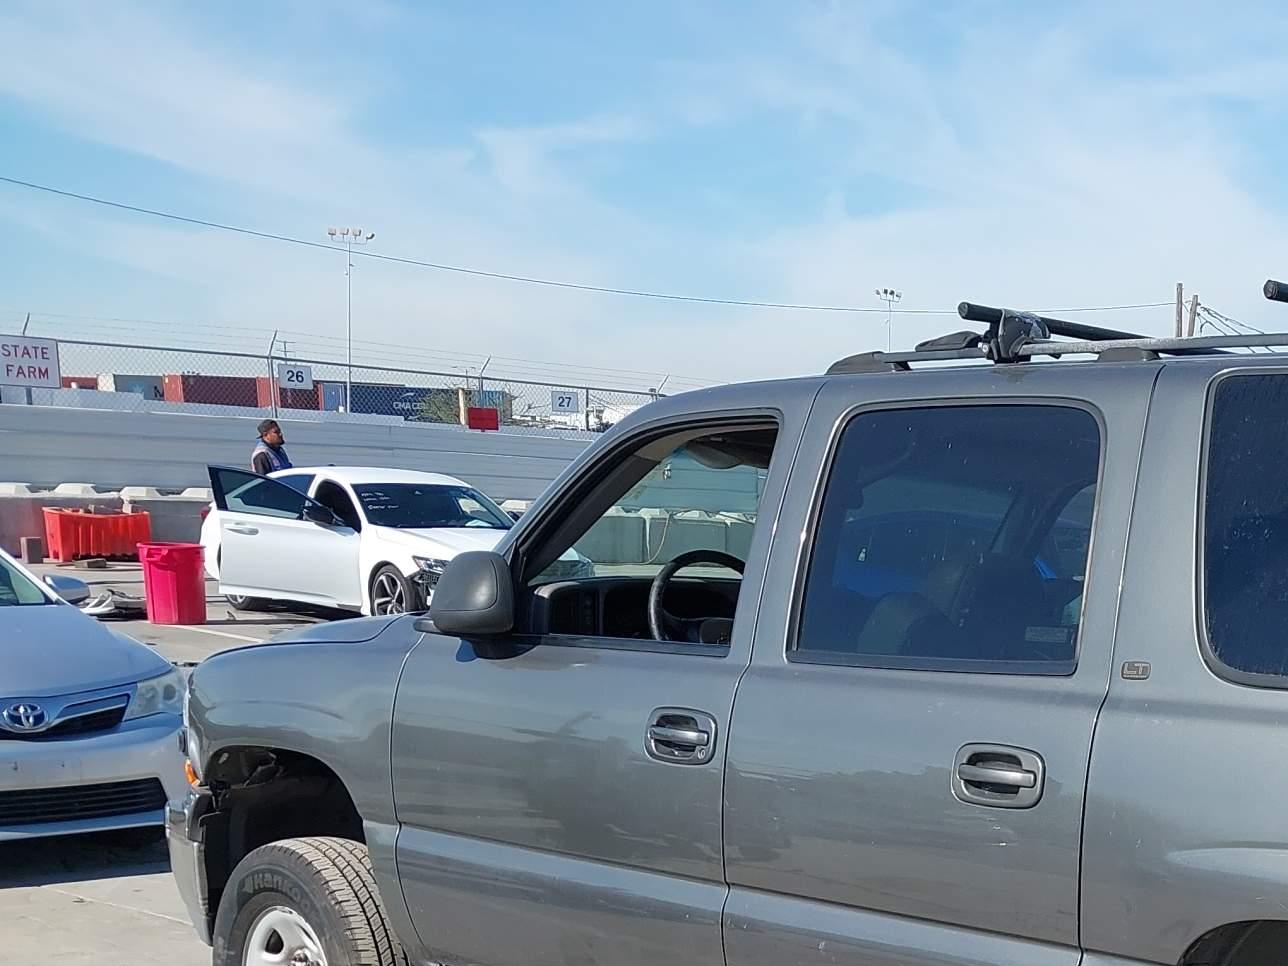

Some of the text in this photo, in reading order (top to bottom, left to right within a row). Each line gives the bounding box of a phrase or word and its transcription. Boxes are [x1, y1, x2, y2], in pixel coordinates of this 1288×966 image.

[1, 343, 50, 361] STATE
[6, 364, 49, 380] FARM
[286, 370, 304, 383] 26
[558, 396, 572, 408] 27
